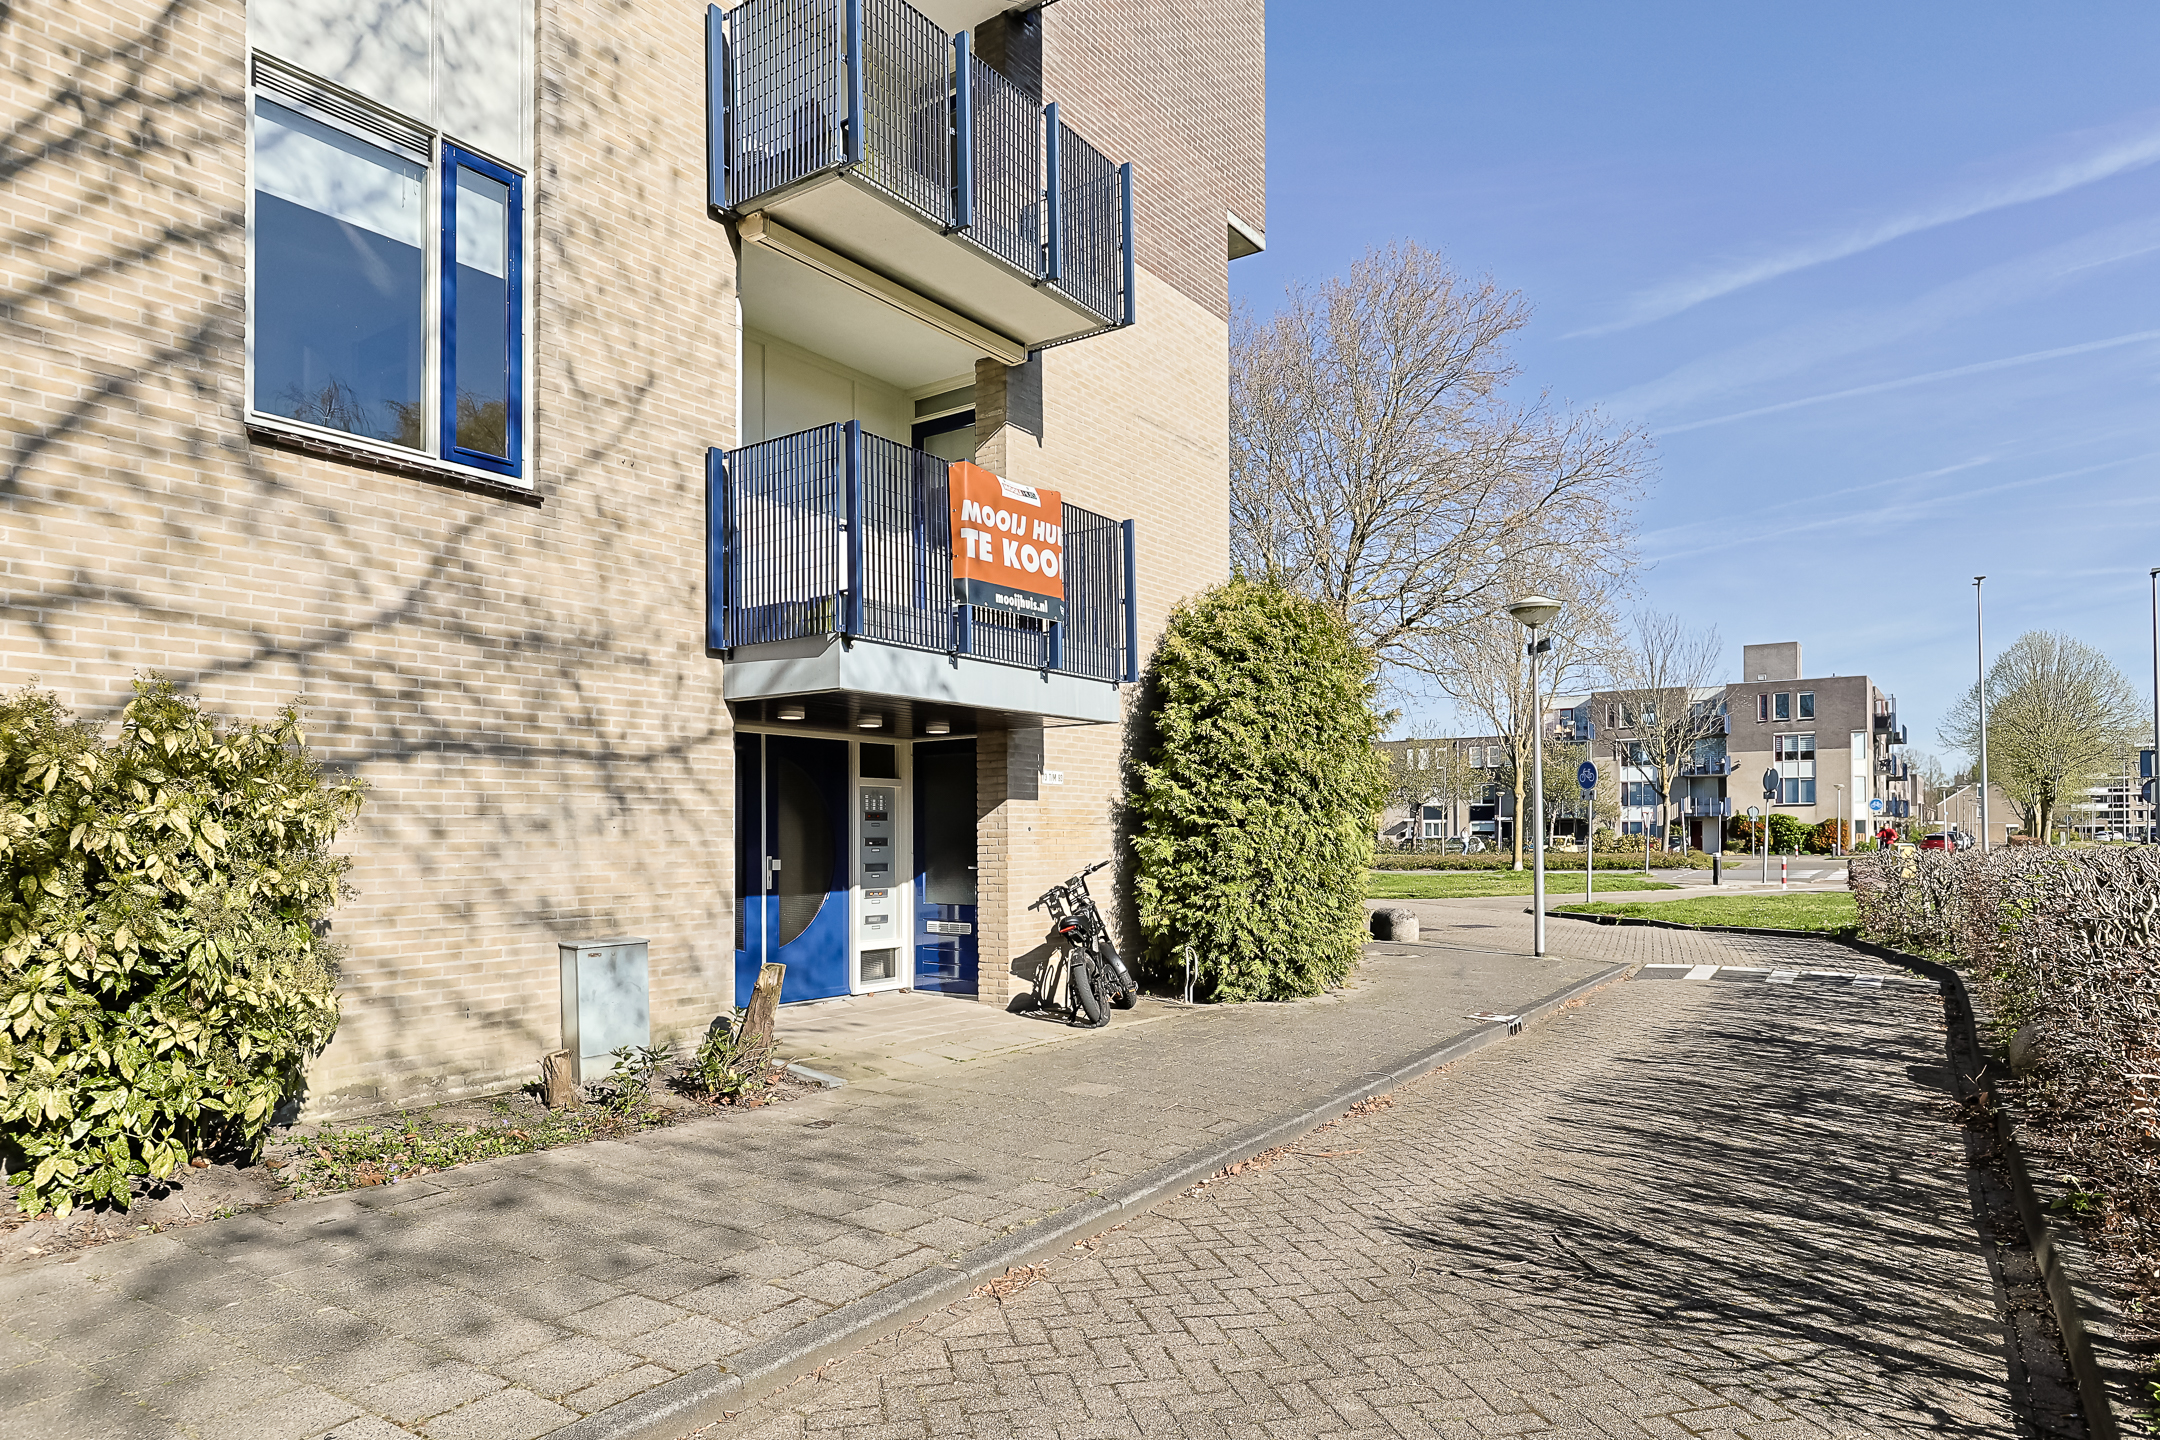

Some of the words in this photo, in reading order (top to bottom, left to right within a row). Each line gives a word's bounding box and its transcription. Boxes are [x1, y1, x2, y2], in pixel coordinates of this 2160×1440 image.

[961, 499, 1027, 537] MOOIJ
[1033, 519, 1062, 547] HUI
[960, 527, 993, 563] TE
[1002, 537, 1062, 580] KOO
[995, 592, 1049, 613] mooijhuis.nl
